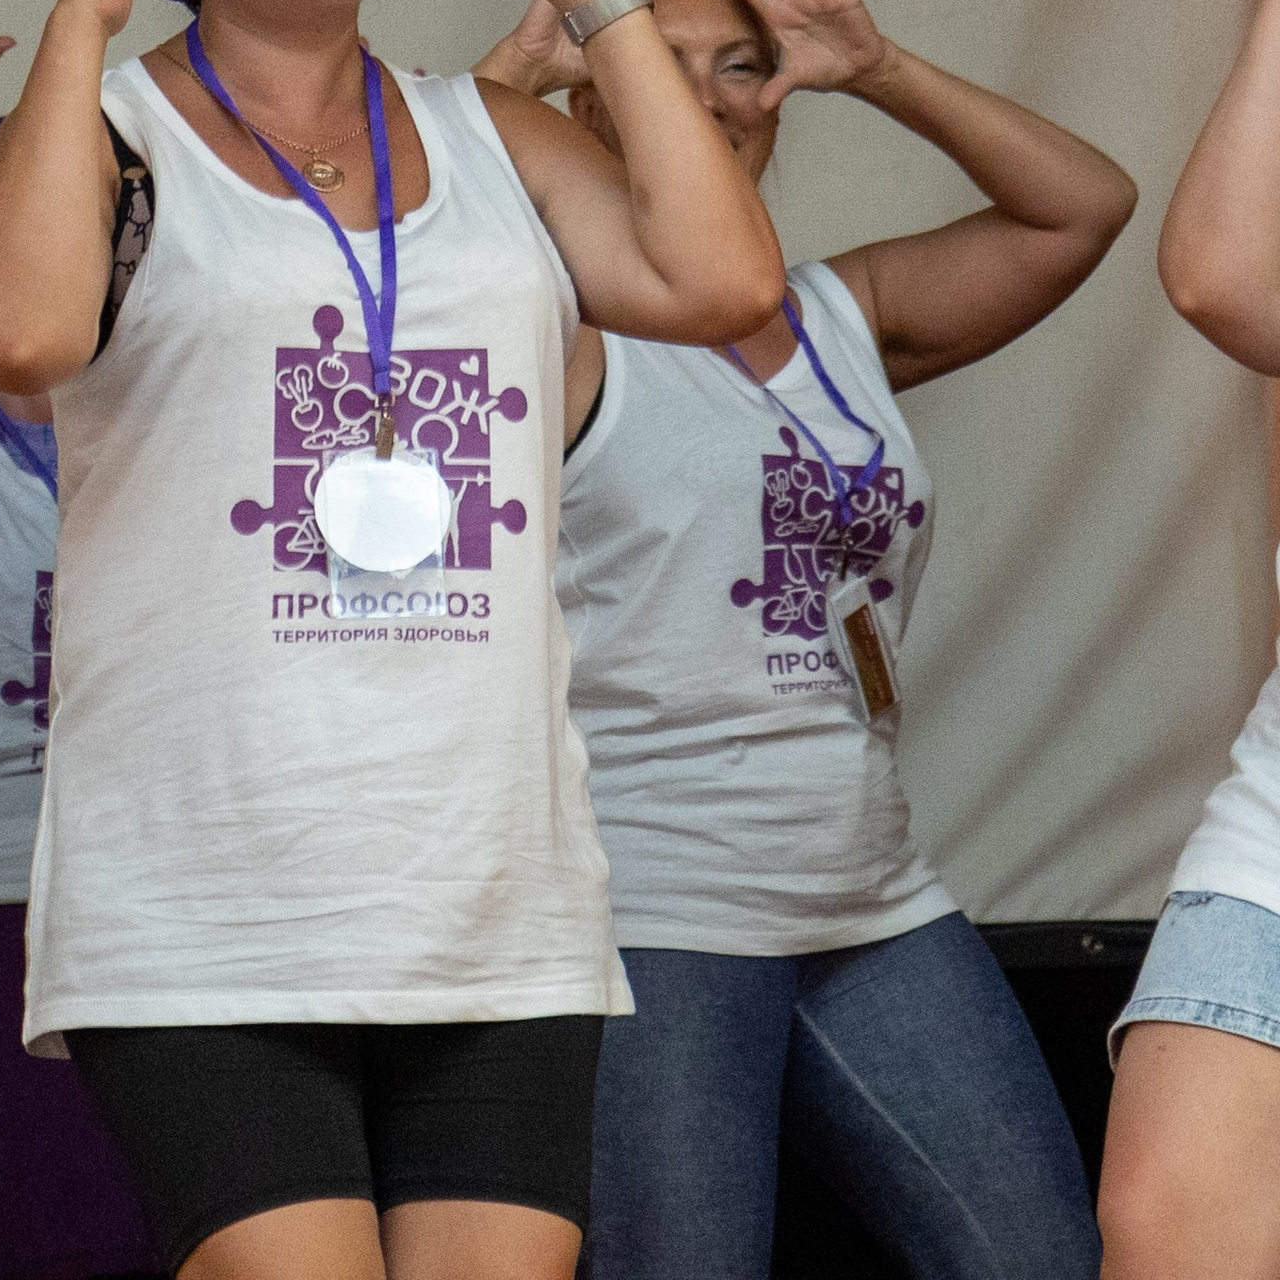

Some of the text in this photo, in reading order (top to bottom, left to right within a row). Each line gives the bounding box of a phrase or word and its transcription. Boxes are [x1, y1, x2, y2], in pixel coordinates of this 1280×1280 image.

[389, 355, 499, 434] ЗОЖ
[272, 591, 491, 619] ПРОФСОЮЗ
[273, 628, 489, 643] ТЕРРИТОРИЯ ЗДОРОВЬЯ
